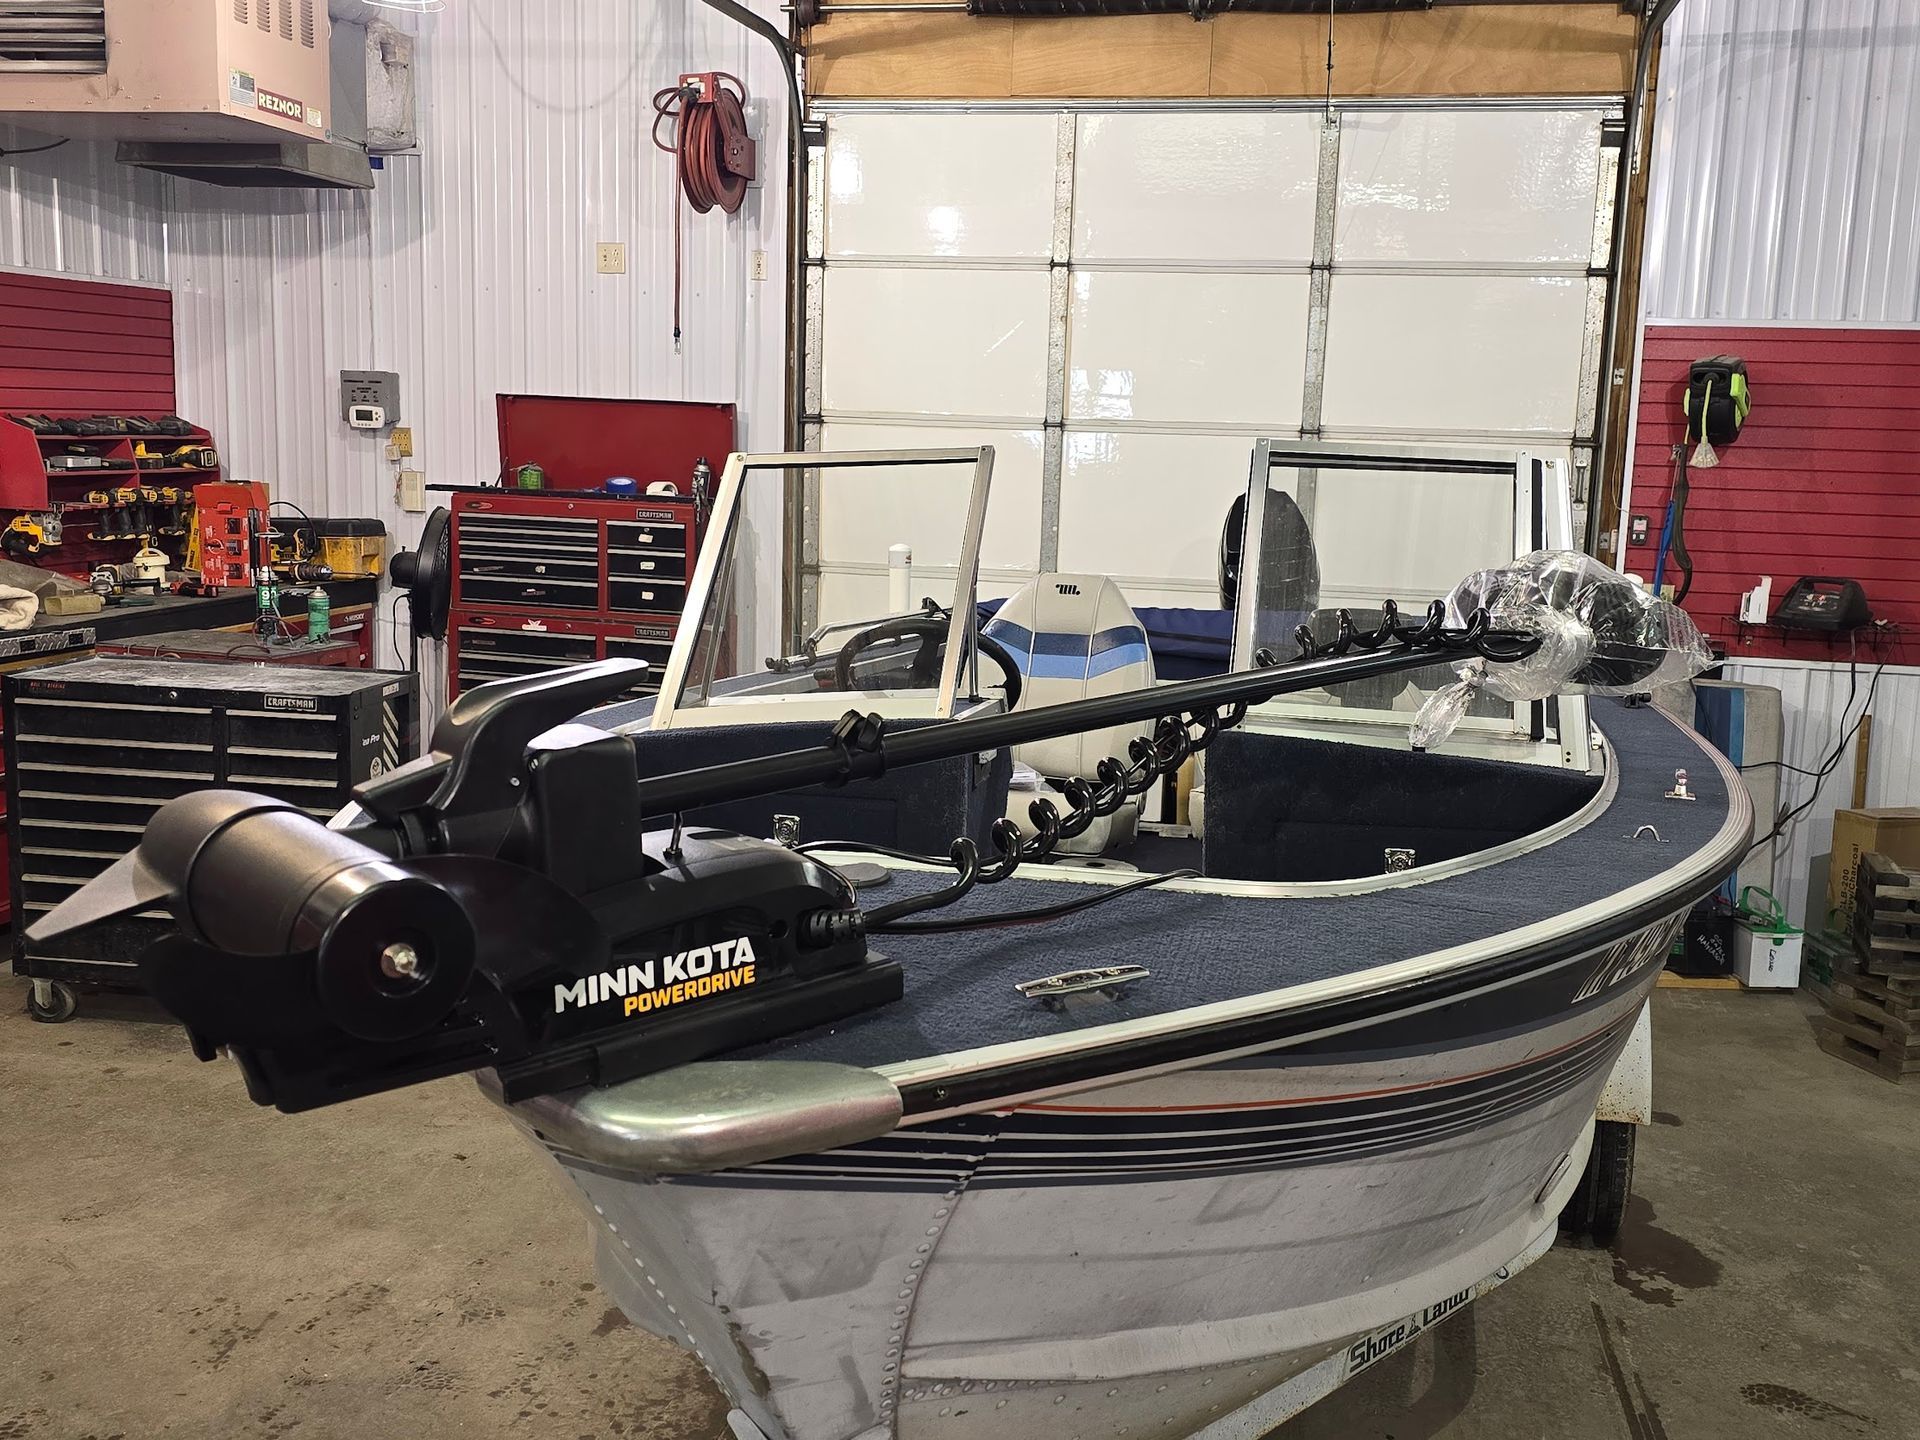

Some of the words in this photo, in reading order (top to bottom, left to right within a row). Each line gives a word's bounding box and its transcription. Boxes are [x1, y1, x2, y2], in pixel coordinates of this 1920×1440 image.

[258, 92, 302, 119] REZNOR
[638, 511, 673, 519] CRAFTSMAN
[635, 628, 669, 637] CRAFTSMAN
[267, 697, 315, 710] CRAFTSMAN
[554, 960, 655, 1013] MINN
[662, 936, 756, 985] KOTA
[623, 964, 756, 1017] POWERDRIVE
[1349, 1324, 1406, 1373] Shore
